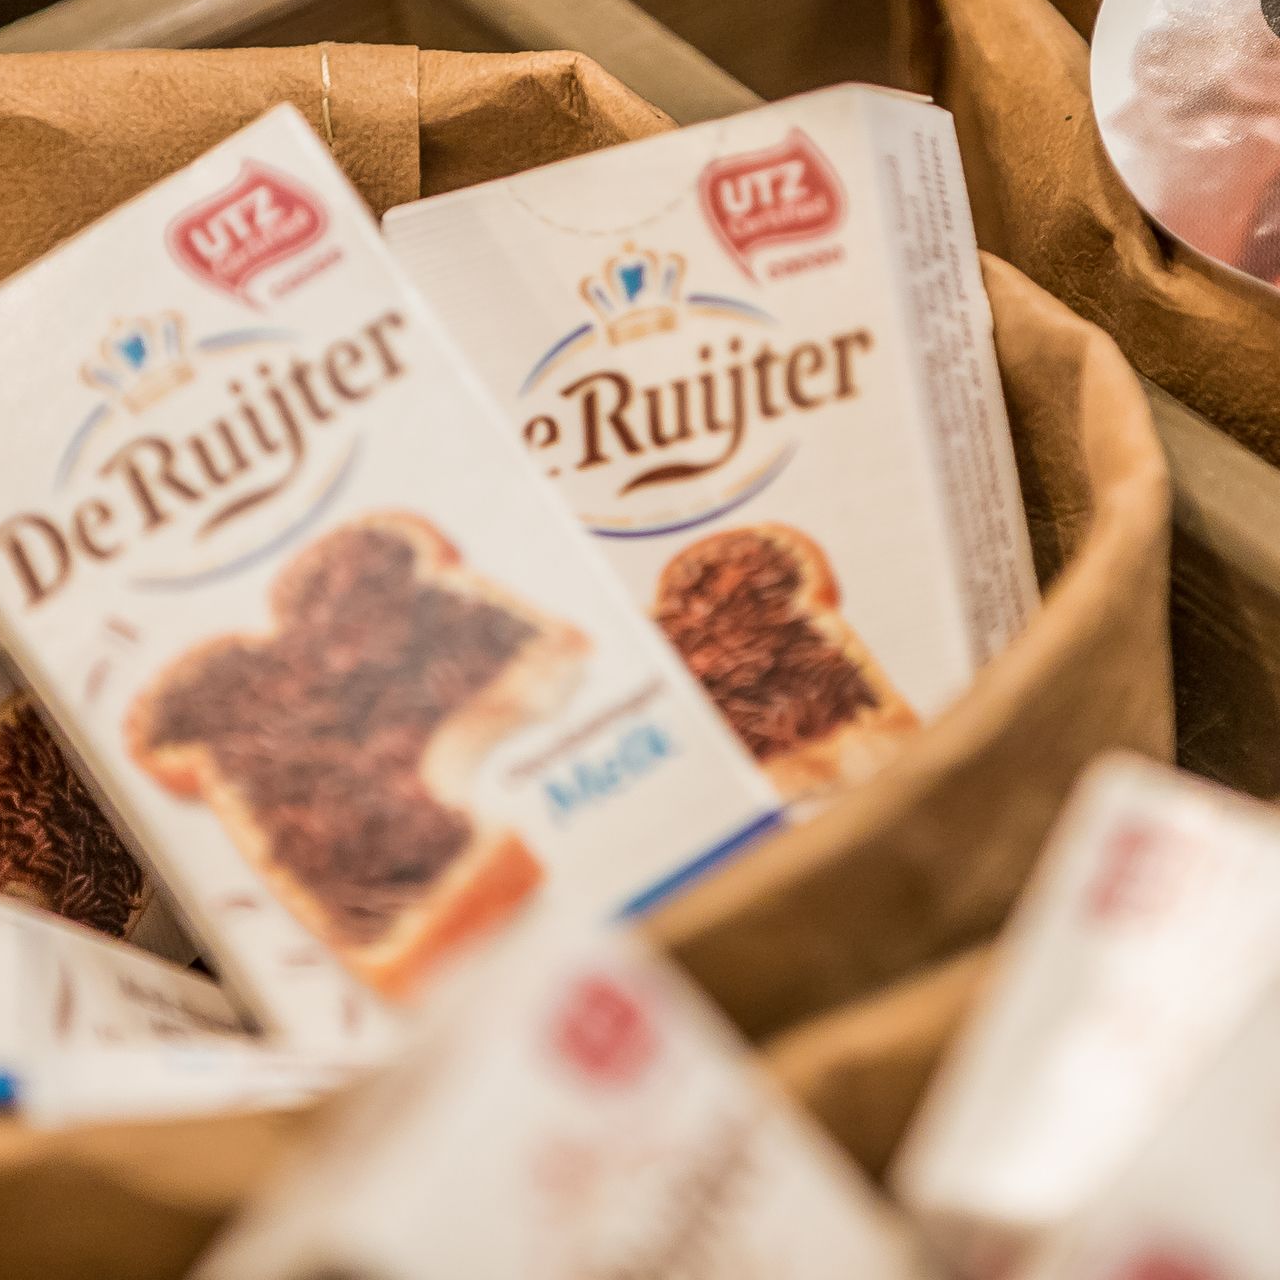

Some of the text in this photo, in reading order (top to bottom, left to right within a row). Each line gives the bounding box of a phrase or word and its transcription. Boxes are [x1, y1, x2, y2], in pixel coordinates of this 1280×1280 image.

[188, 185, 283, 258] UTZ
[722, 158, 811, 217] UTZ
[560, 326, 874, 498] Ruijter
